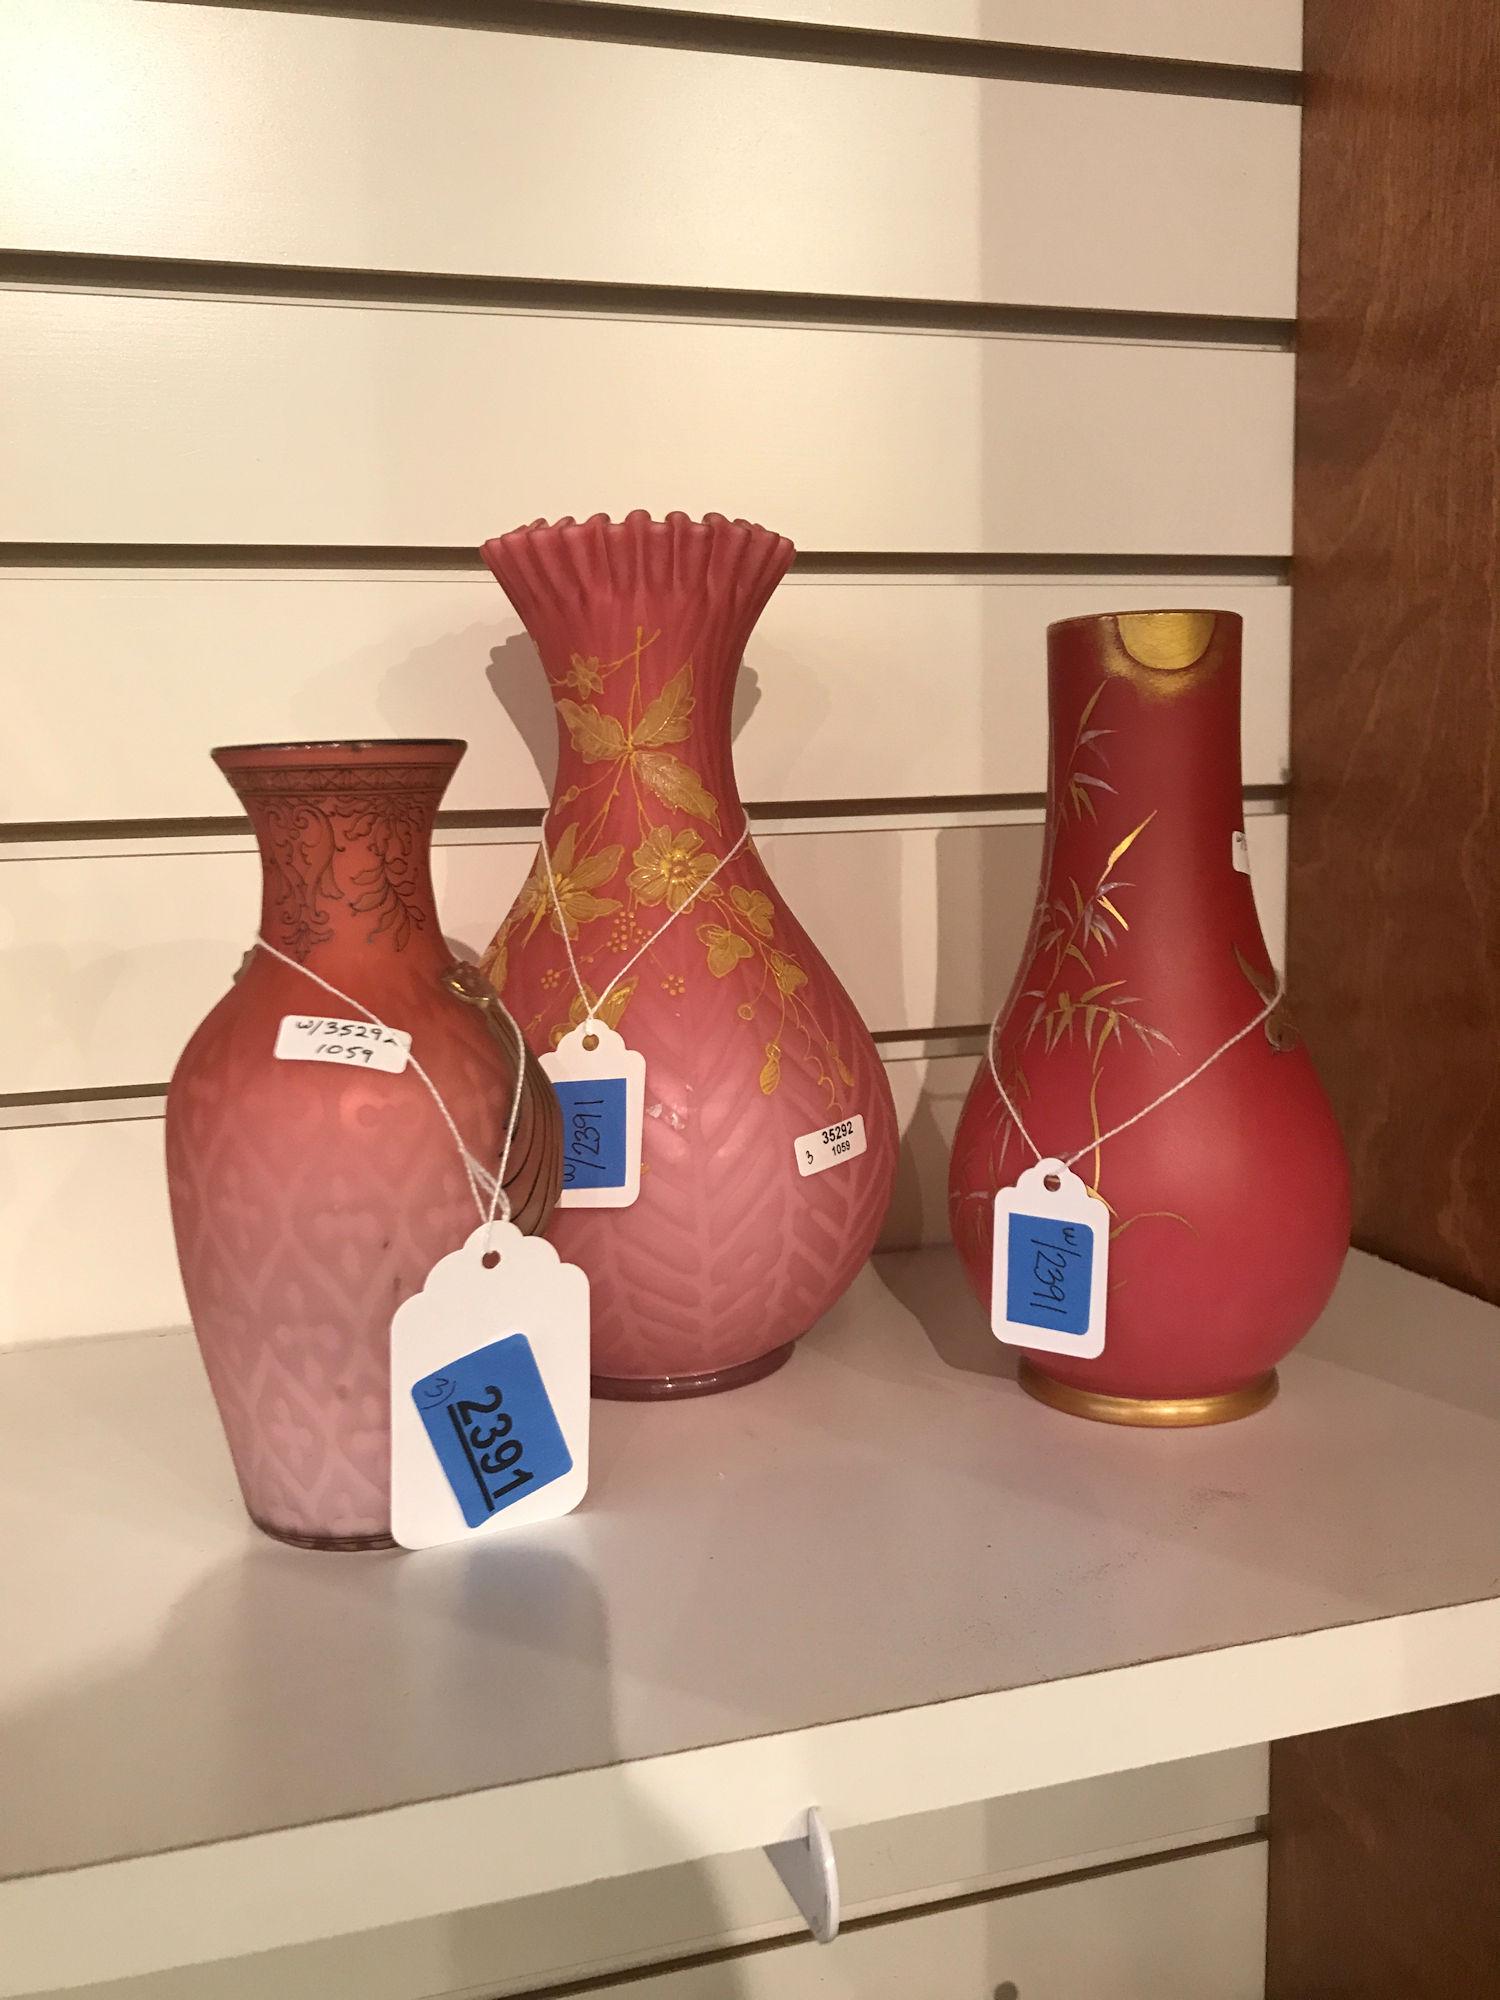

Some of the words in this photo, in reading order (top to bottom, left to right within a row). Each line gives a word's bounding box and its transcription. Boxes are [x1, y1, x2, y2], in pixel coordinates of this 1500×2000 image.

[316, 1044, 374, 1063] 1059
[822, 1121, 854, 1145] 35292
[831, 1140, 851, 1156] 1059
[456, 1384, 534, 1499] 2391
